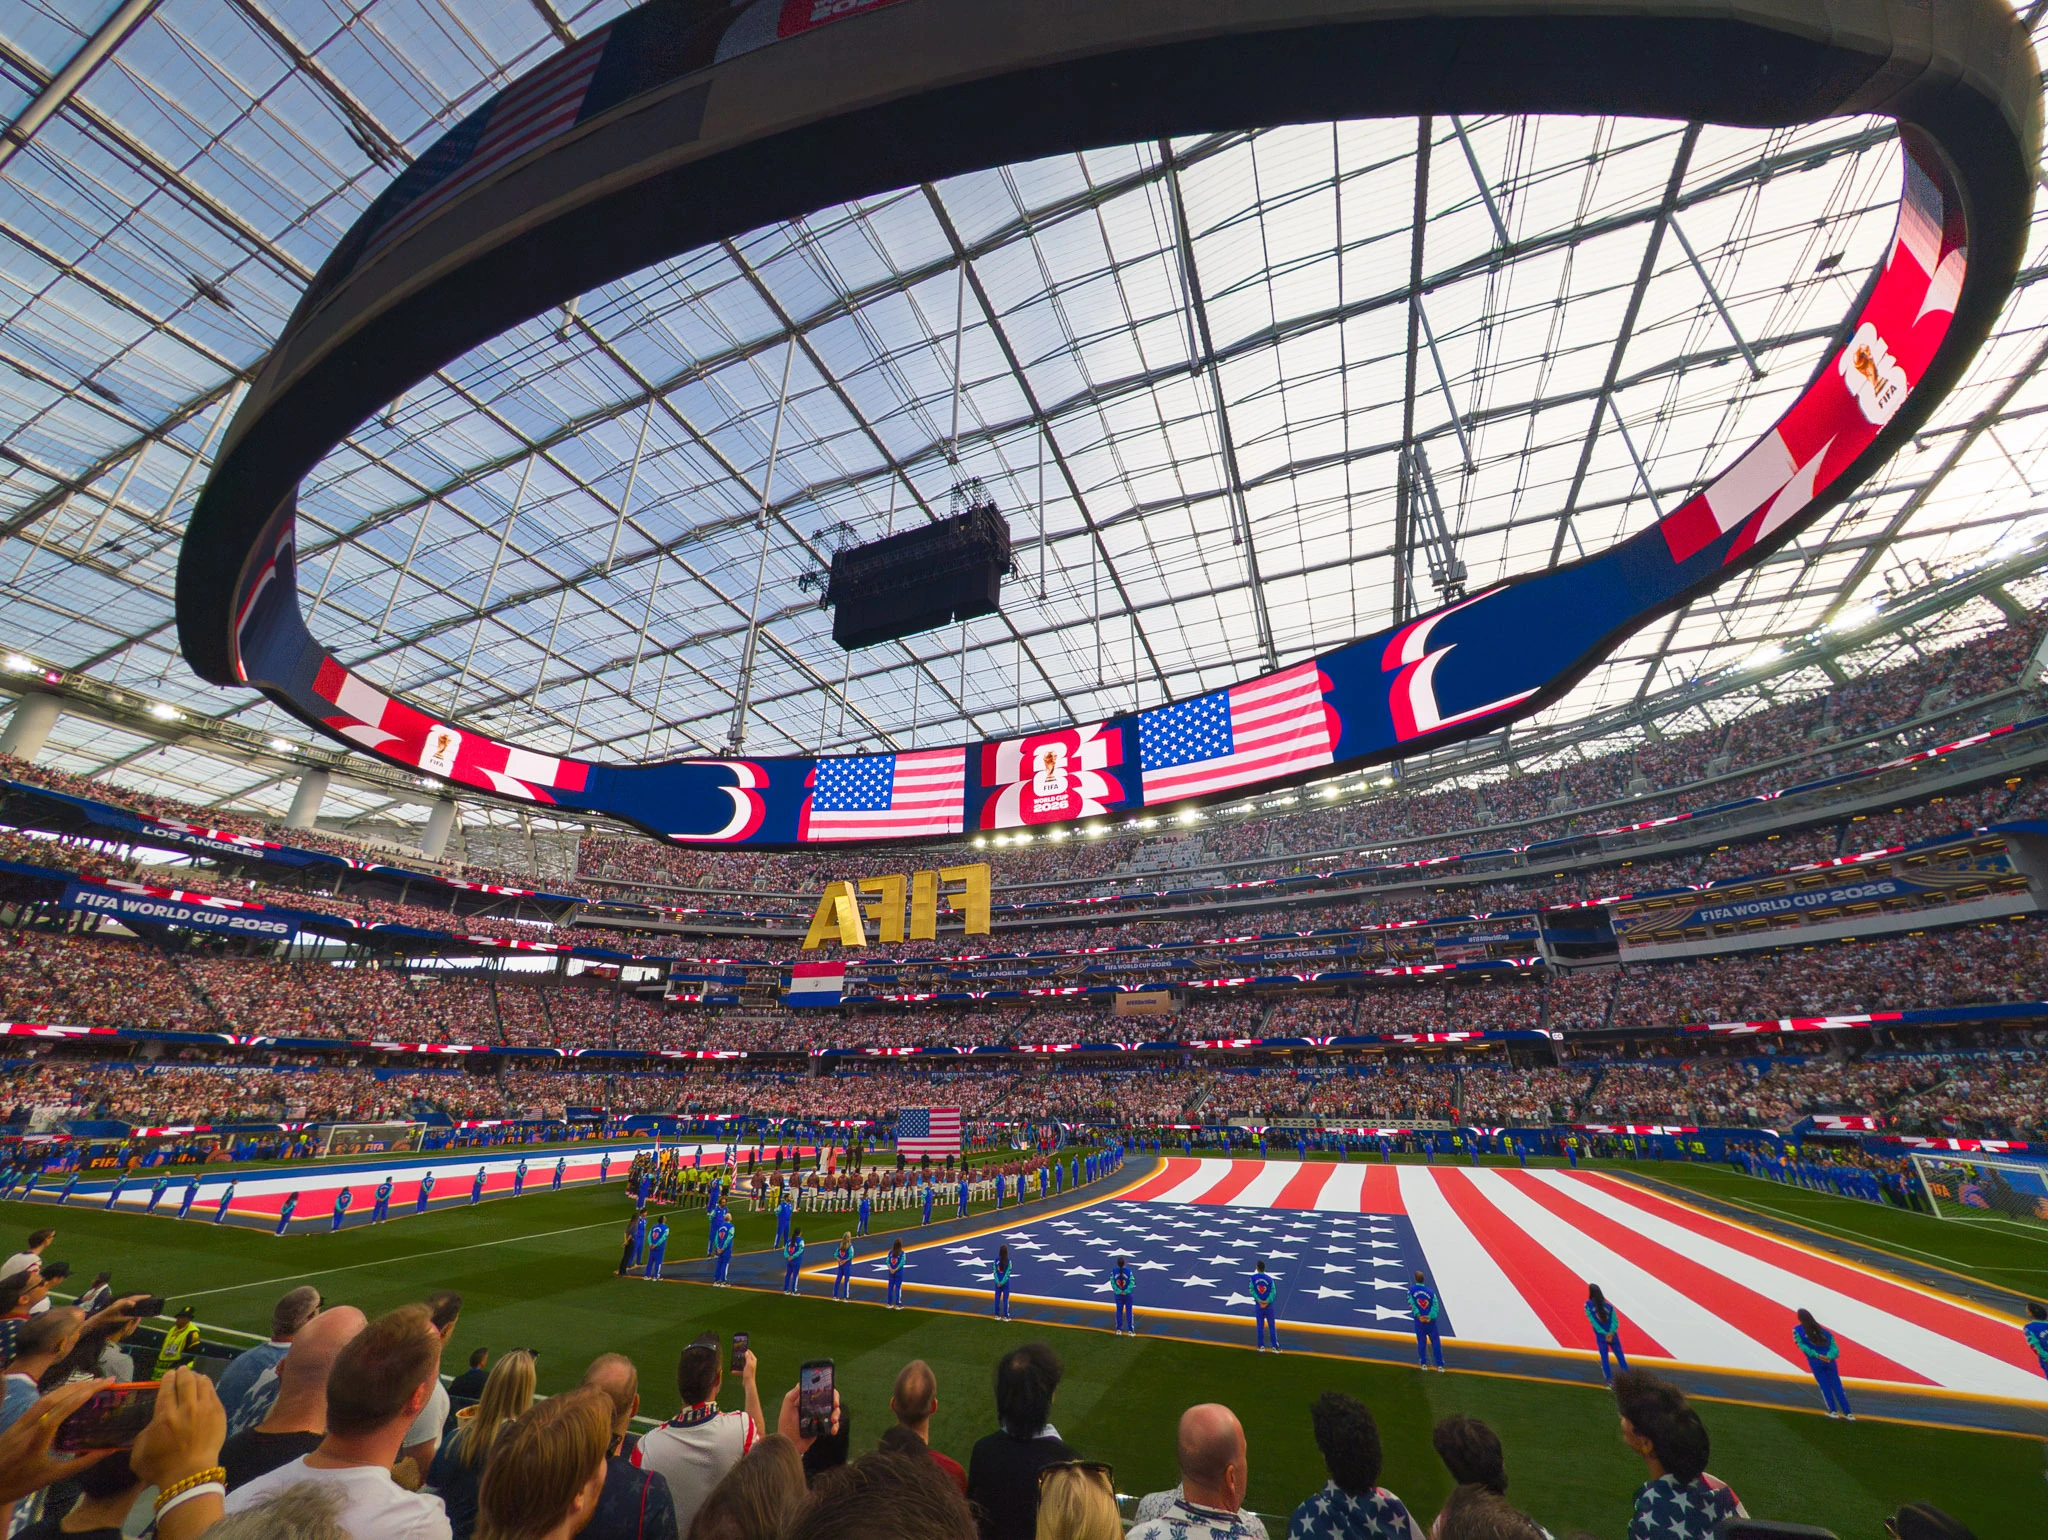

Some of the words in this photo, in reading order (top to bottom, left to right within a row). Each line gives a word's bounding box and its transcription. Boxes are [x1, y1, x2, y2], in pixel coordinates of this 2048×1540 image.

[1878, 384, 1897, 409] FIFA
[430, 759, 444, 767] FIFA
[1034, 796, 1055, 804] WORLD
[1033, 800, 1069, 813] 2026
[142, 826, 181, 840] LOS
[184, 836, 264, 858] ANGELES
[1700, 908, 1732, 922] FIFA
[1734, 899, 1791, 915] WORLD
[1793, 893, 1827, 907] CUP
[1829, 882, 1896, 902] 2026
[75, 892, 118, 910] FIFA
[122, 899, 190, 921] WORLD
[192, 911, 229, 926] CUP
[228, 916, 288, 934] 2026
[1287, 949, 1336, 958] ANGELES
[990, 969, 1028, 977] ANGELES
[364, 1143, 384, 1151] FIFA
